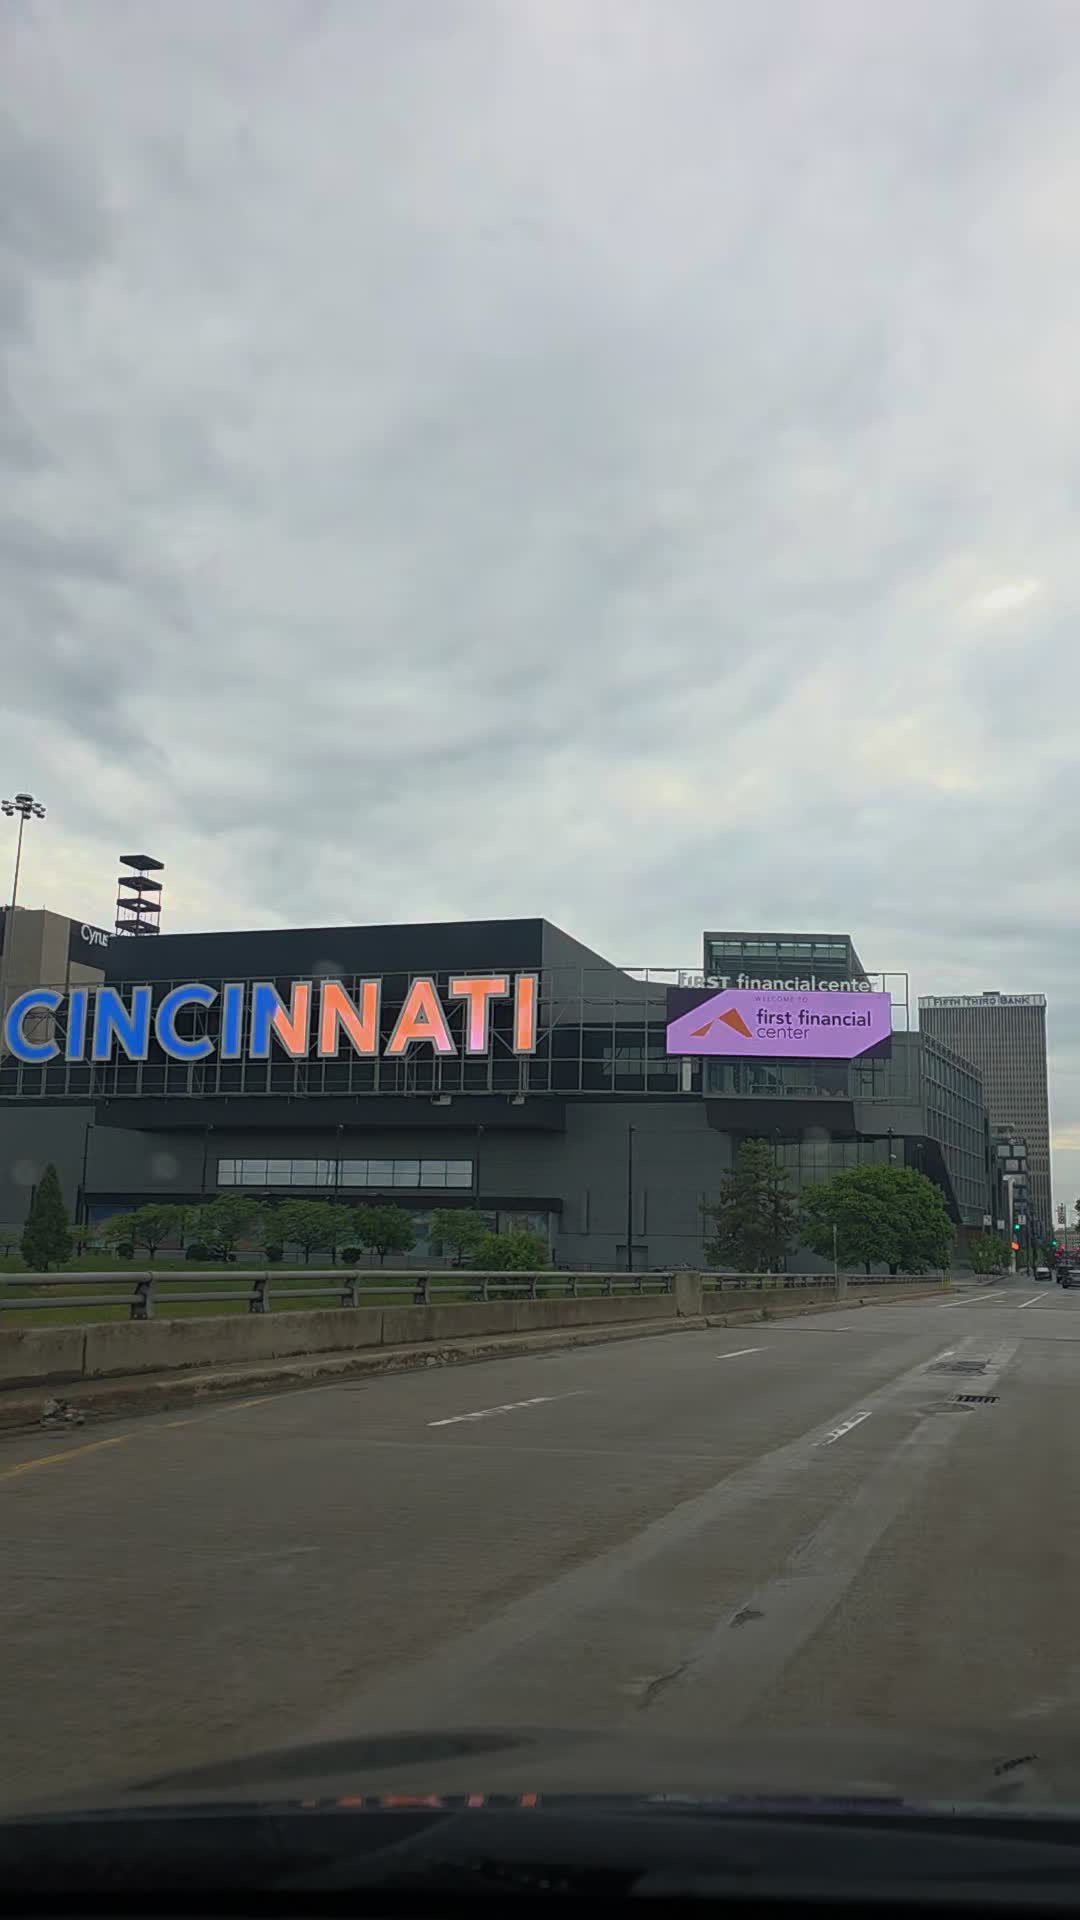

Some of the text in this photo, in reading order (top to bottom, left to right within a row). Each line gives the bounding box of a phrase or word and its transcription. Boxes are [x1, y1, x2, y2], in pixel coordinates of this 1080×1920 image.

[1000, 996, 1030, 1006] BANK
[4, 973, 538, 1062] CINCINNATI
[756, 1008, 871, 1027] first financial
[756, 1026, 810, 1040] center
